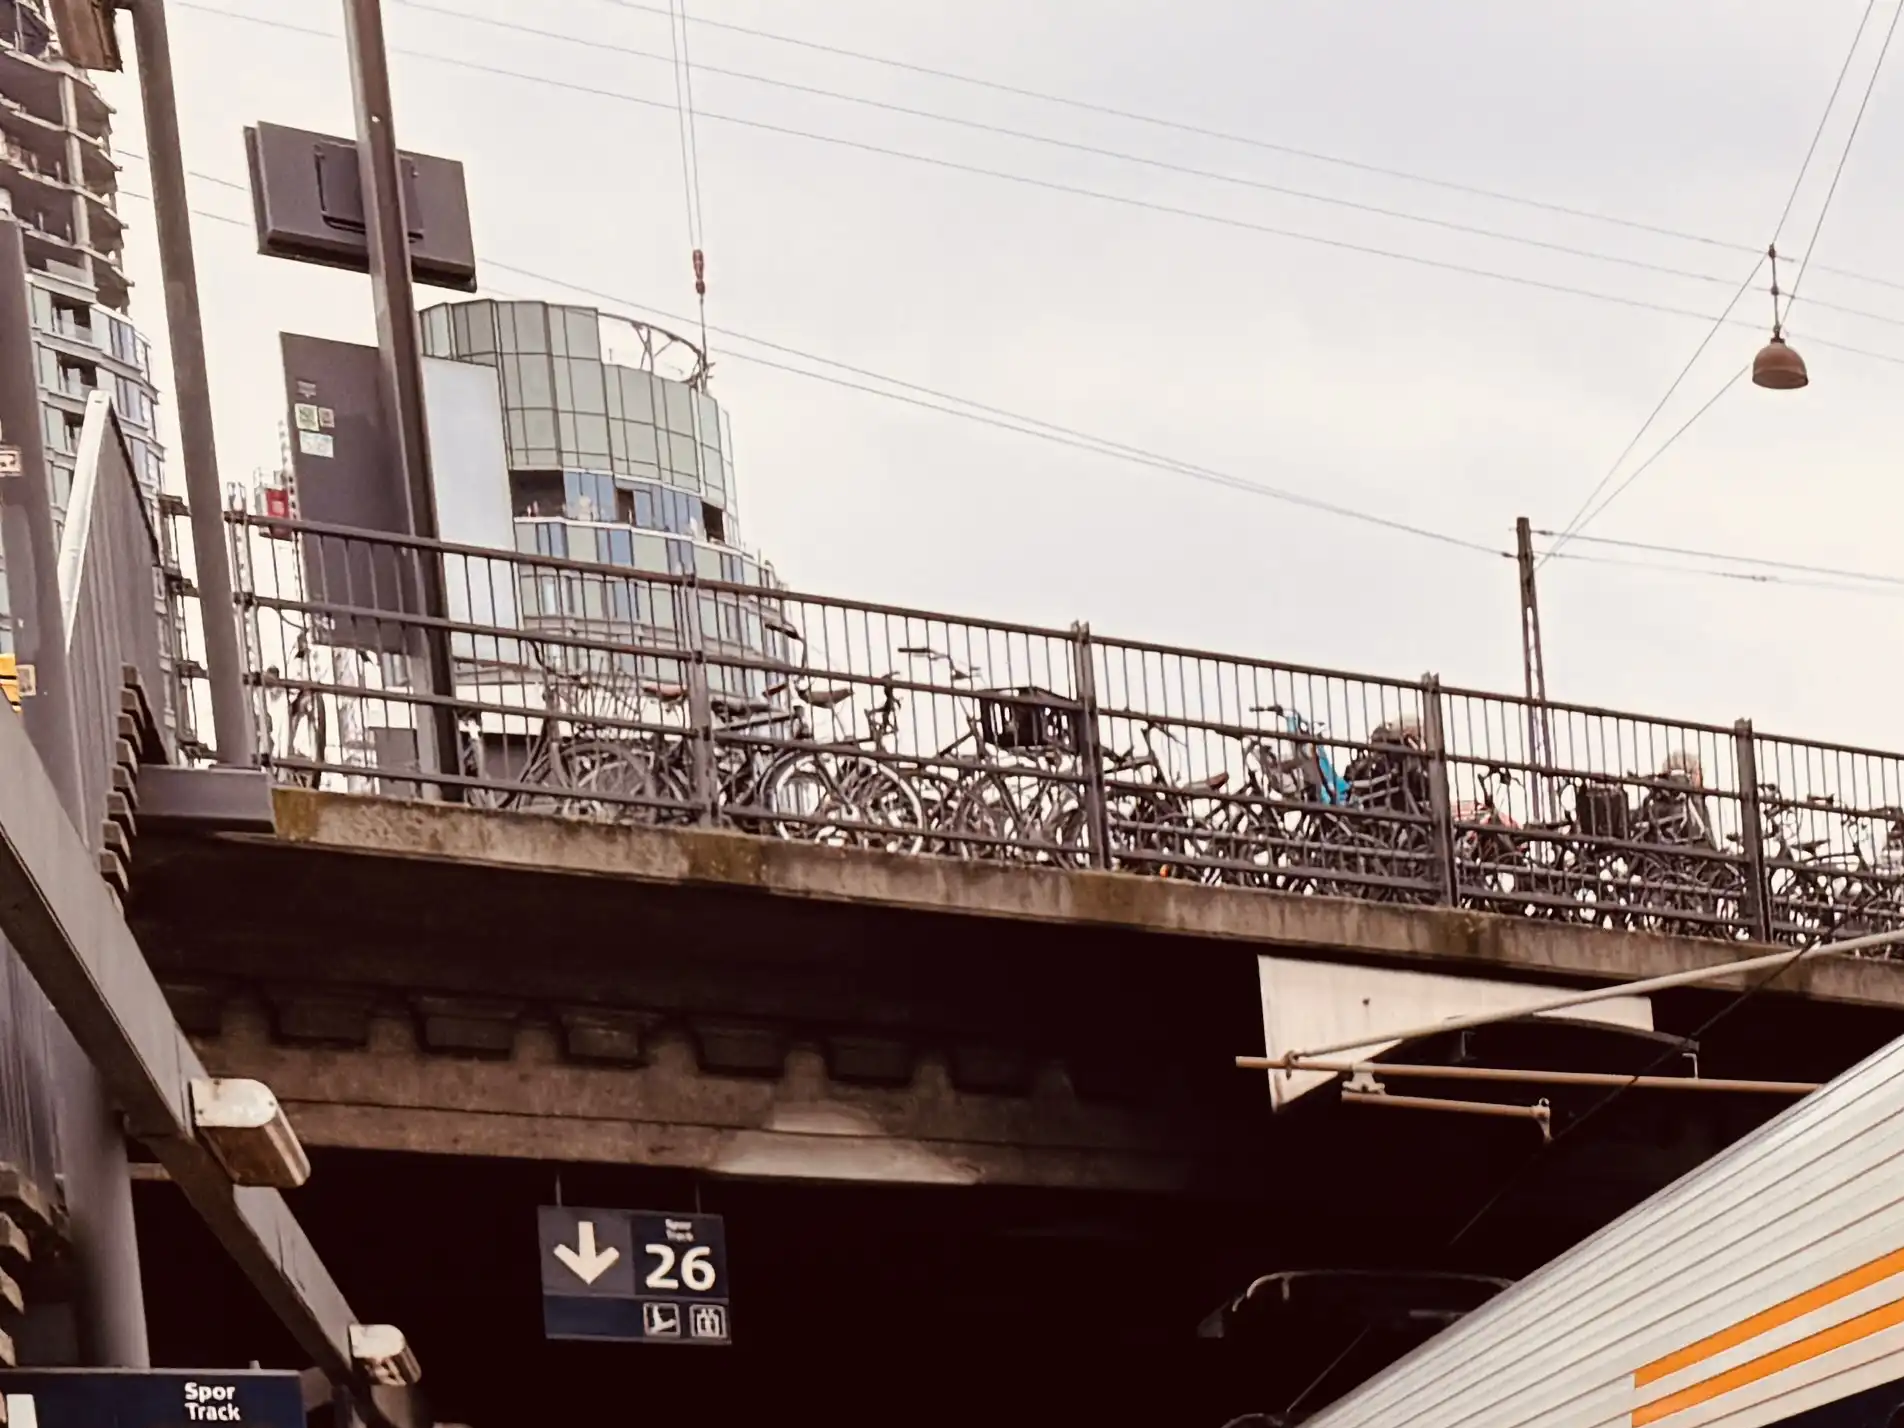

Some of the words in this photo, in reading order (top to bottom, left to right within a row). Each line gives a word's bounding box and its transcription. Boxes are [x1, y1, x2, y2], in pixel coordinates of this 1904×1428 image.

[645, 1243, 716, 1291] 26
[184, 1382, 235, 1402] Spor
[184, 1402, 241, 1421] Track
